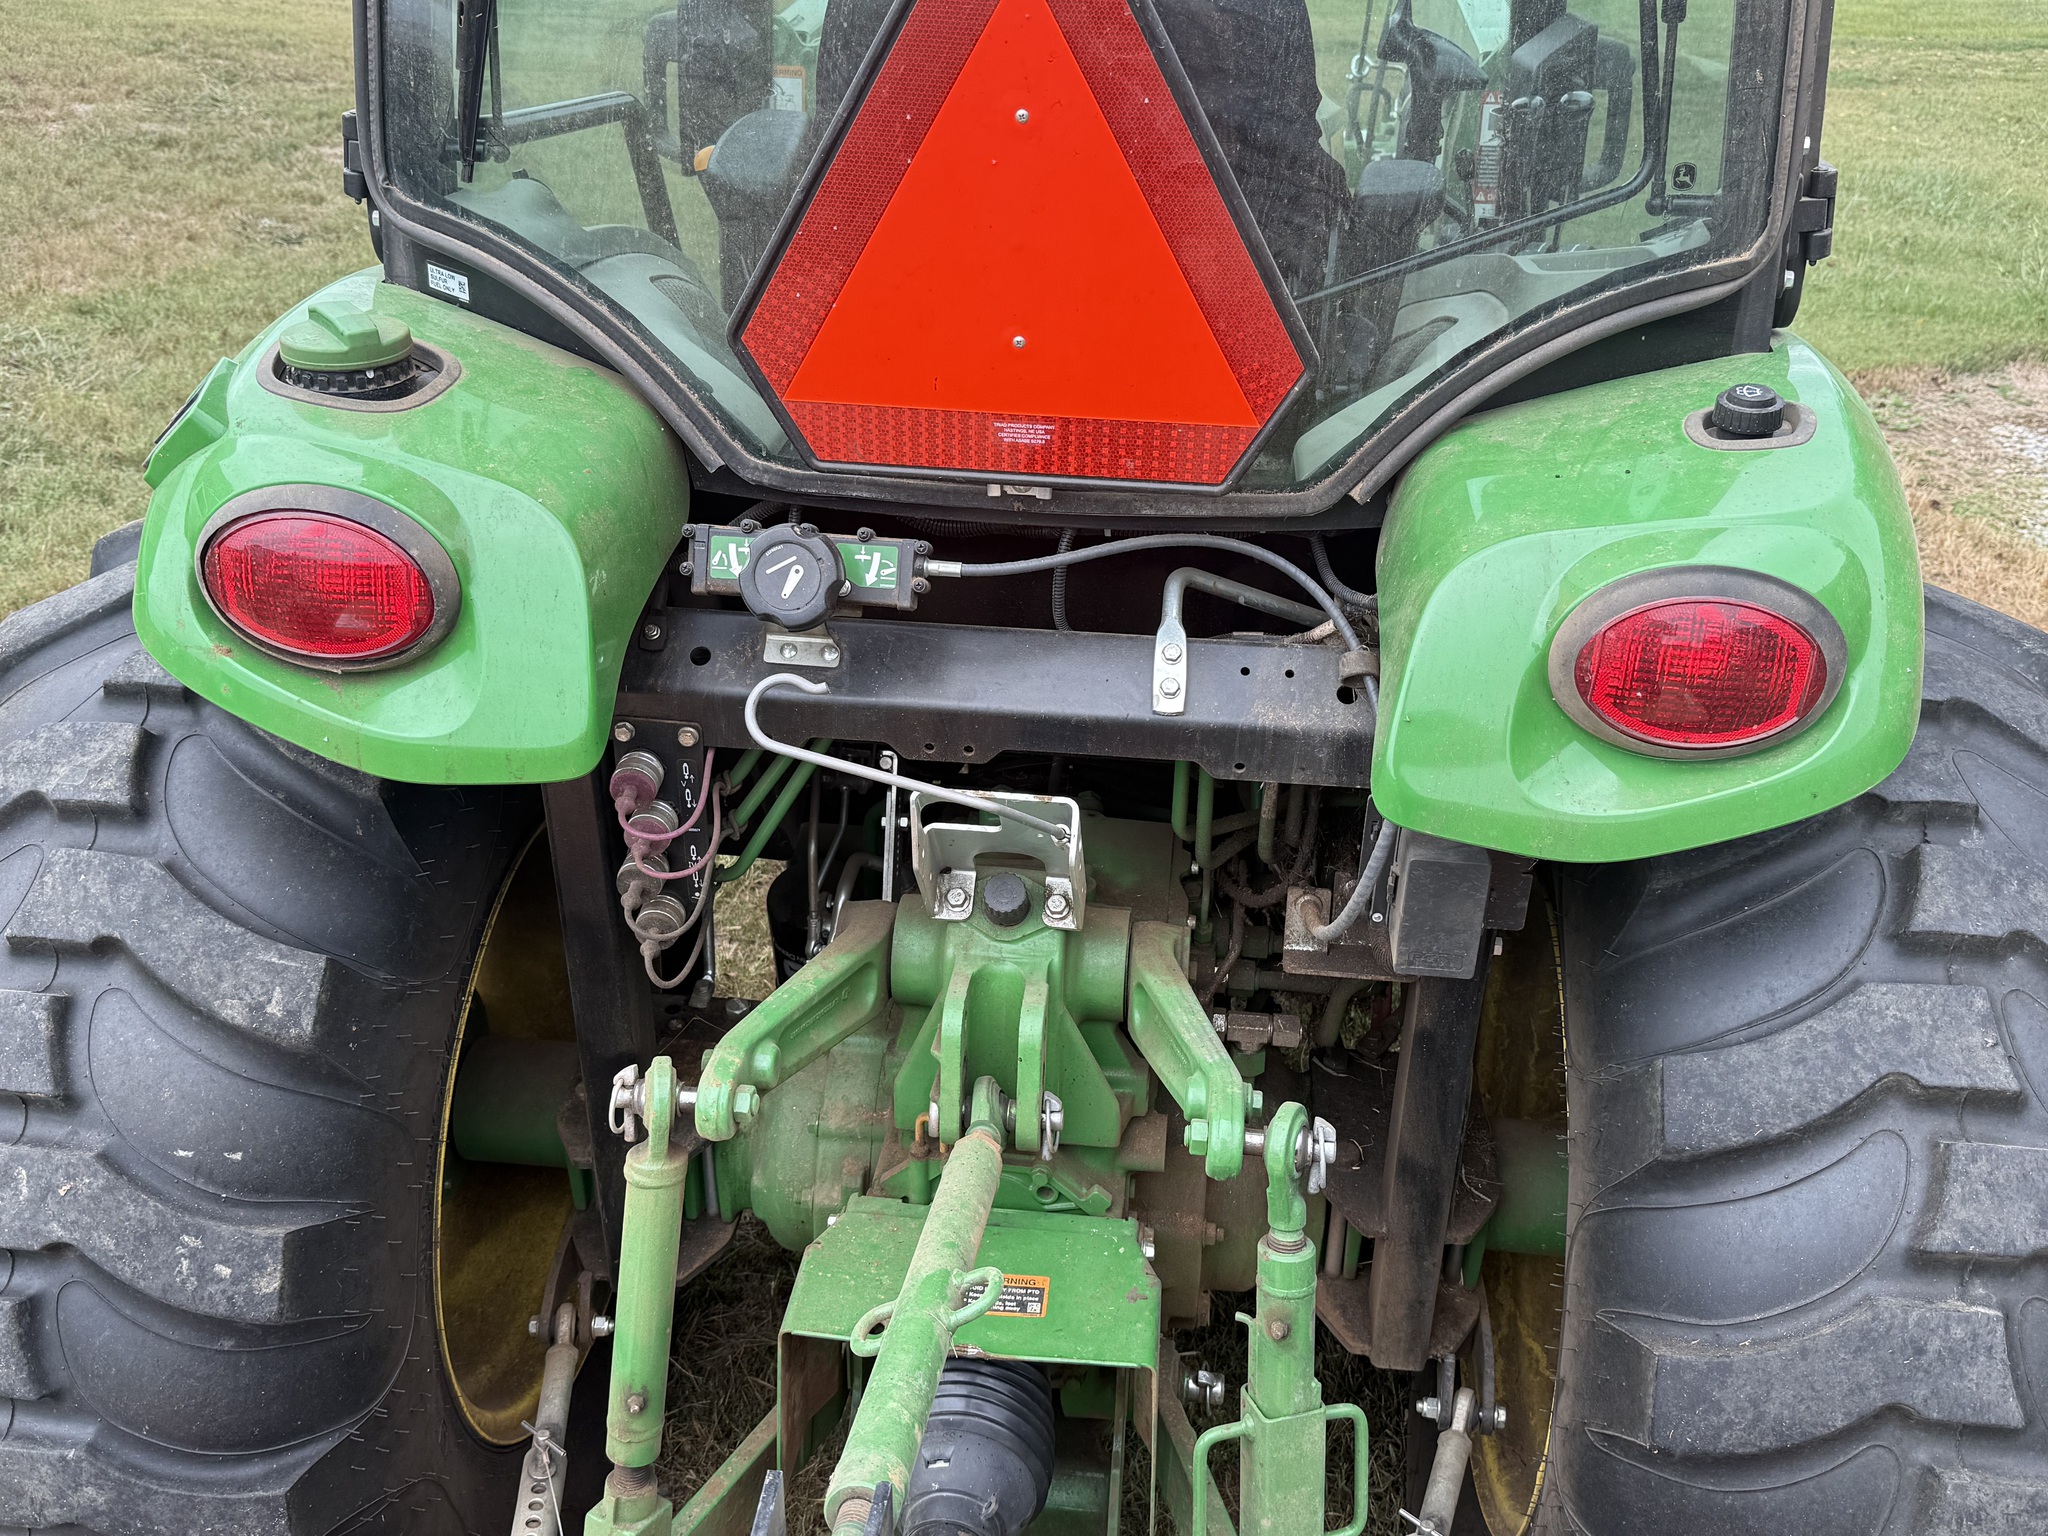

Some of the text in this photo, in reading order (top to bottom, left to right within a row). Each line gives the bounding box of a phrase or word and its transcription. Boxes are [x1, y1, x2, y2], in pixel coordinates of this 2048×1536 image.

[430, 267, 444, 276] ULTRA
[430, 274, 448, 284] SULFUR
[431, 280, 455, 293] FUEL ONLY
[1004, 1278, 1036, 1286] RNING
